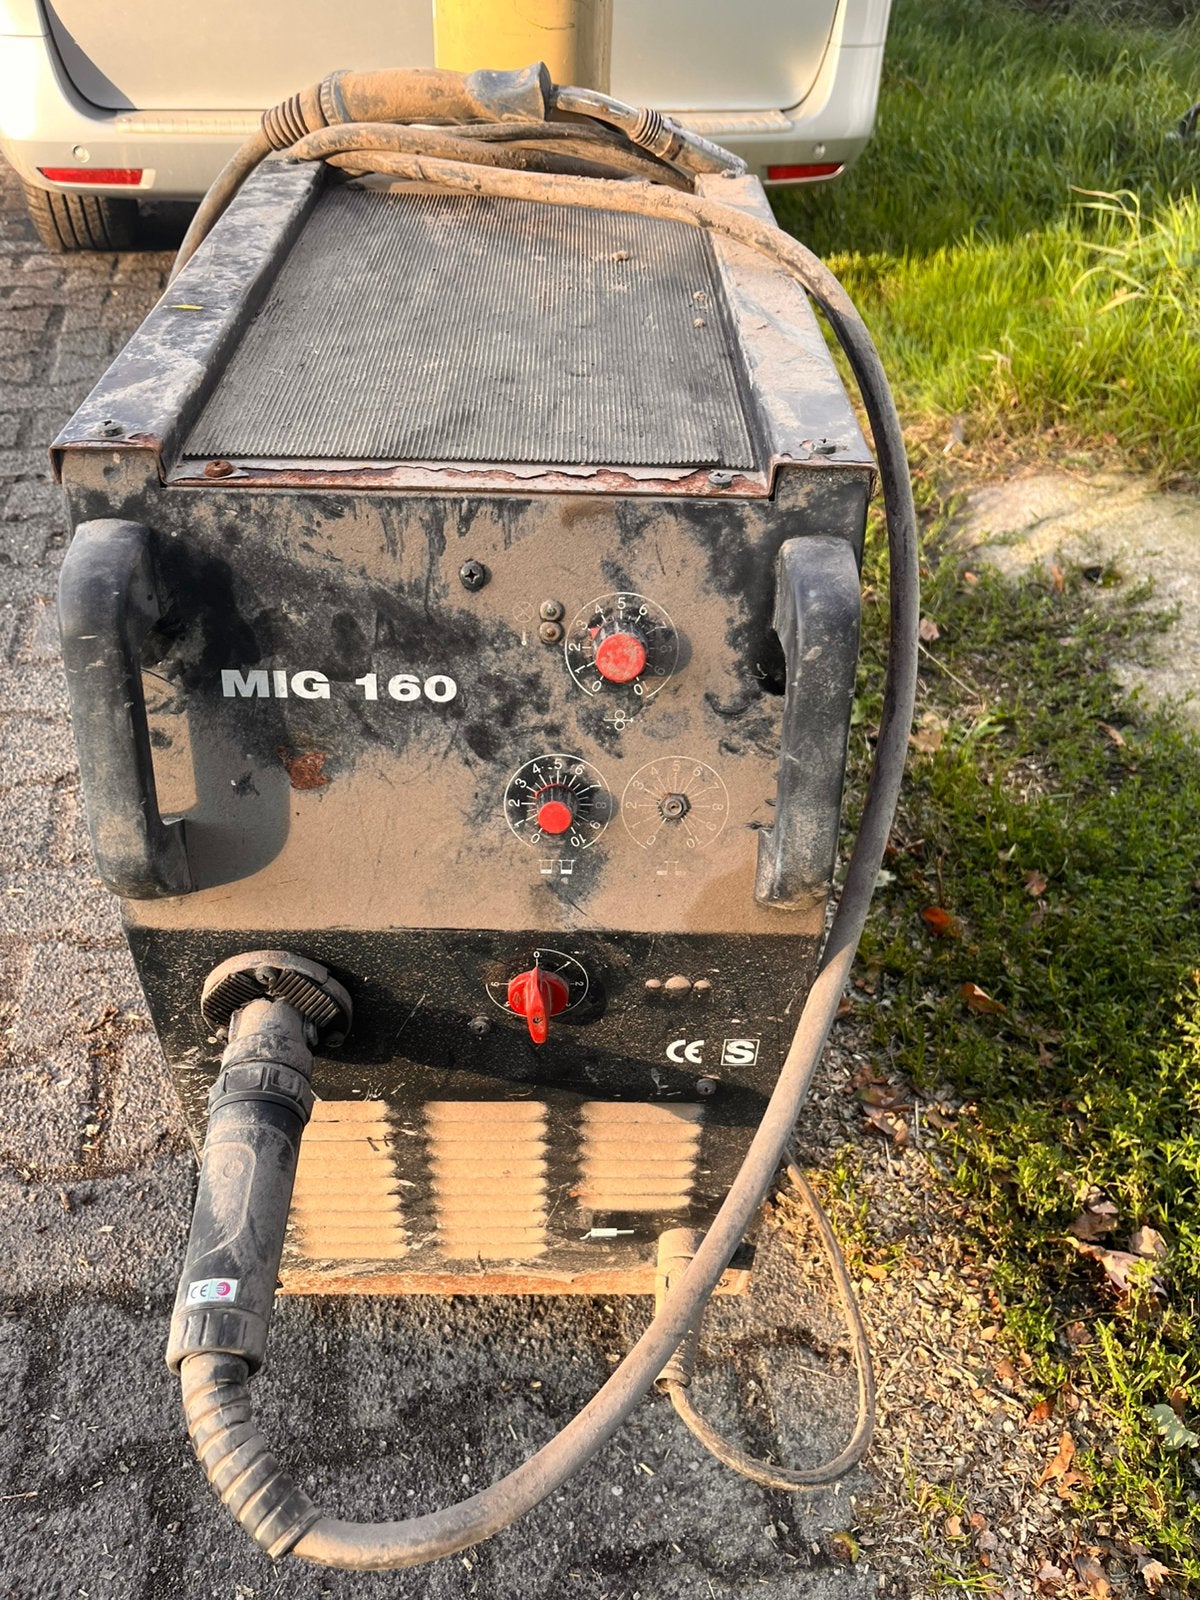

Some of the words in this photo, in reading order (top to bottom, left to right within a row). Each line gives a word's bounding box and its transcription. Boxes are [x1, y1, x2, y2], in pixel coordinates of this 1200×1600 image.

[595, 604, 604, 614] 4
[617, 597, 626, 610] 5
[638, 603, 649, 616] 6
[576, 619, 588, 631] 3
[568, 642, 581, 652] 2
[574, 664, 586, 674] 1
[220, 668, 332, 700] MIG
[355, 672, 459, 703] 160
[591, 680, 602, 692] 0
[532, 763, 541, 774] 4
[554, 758, 563, 770] 5
[574, 763, 585, 775] 6
[672, 760, 681, 772] 5
[650, 766, 659, 776] 4
[692, 765, 703, 777] 6
[514, 778, 527, 789] 3
[632, 780, 645, 790] 3
[508, 799, 520, 808] 2
[595, 801, 607, 809] 8
[625, 801, 637, 810] 2
[712, 803, 724, 811] 8
[514, 818, 525, 827] 1
[530, 832, 541, 844] 0
[570, 833, 587, 848] 10
[646, 834, 656, 846] 0
[665, 1039, 705, 1064] CE
[724, 1040, 755, 1064] S
[190, 1283, 209, 1300] CE
